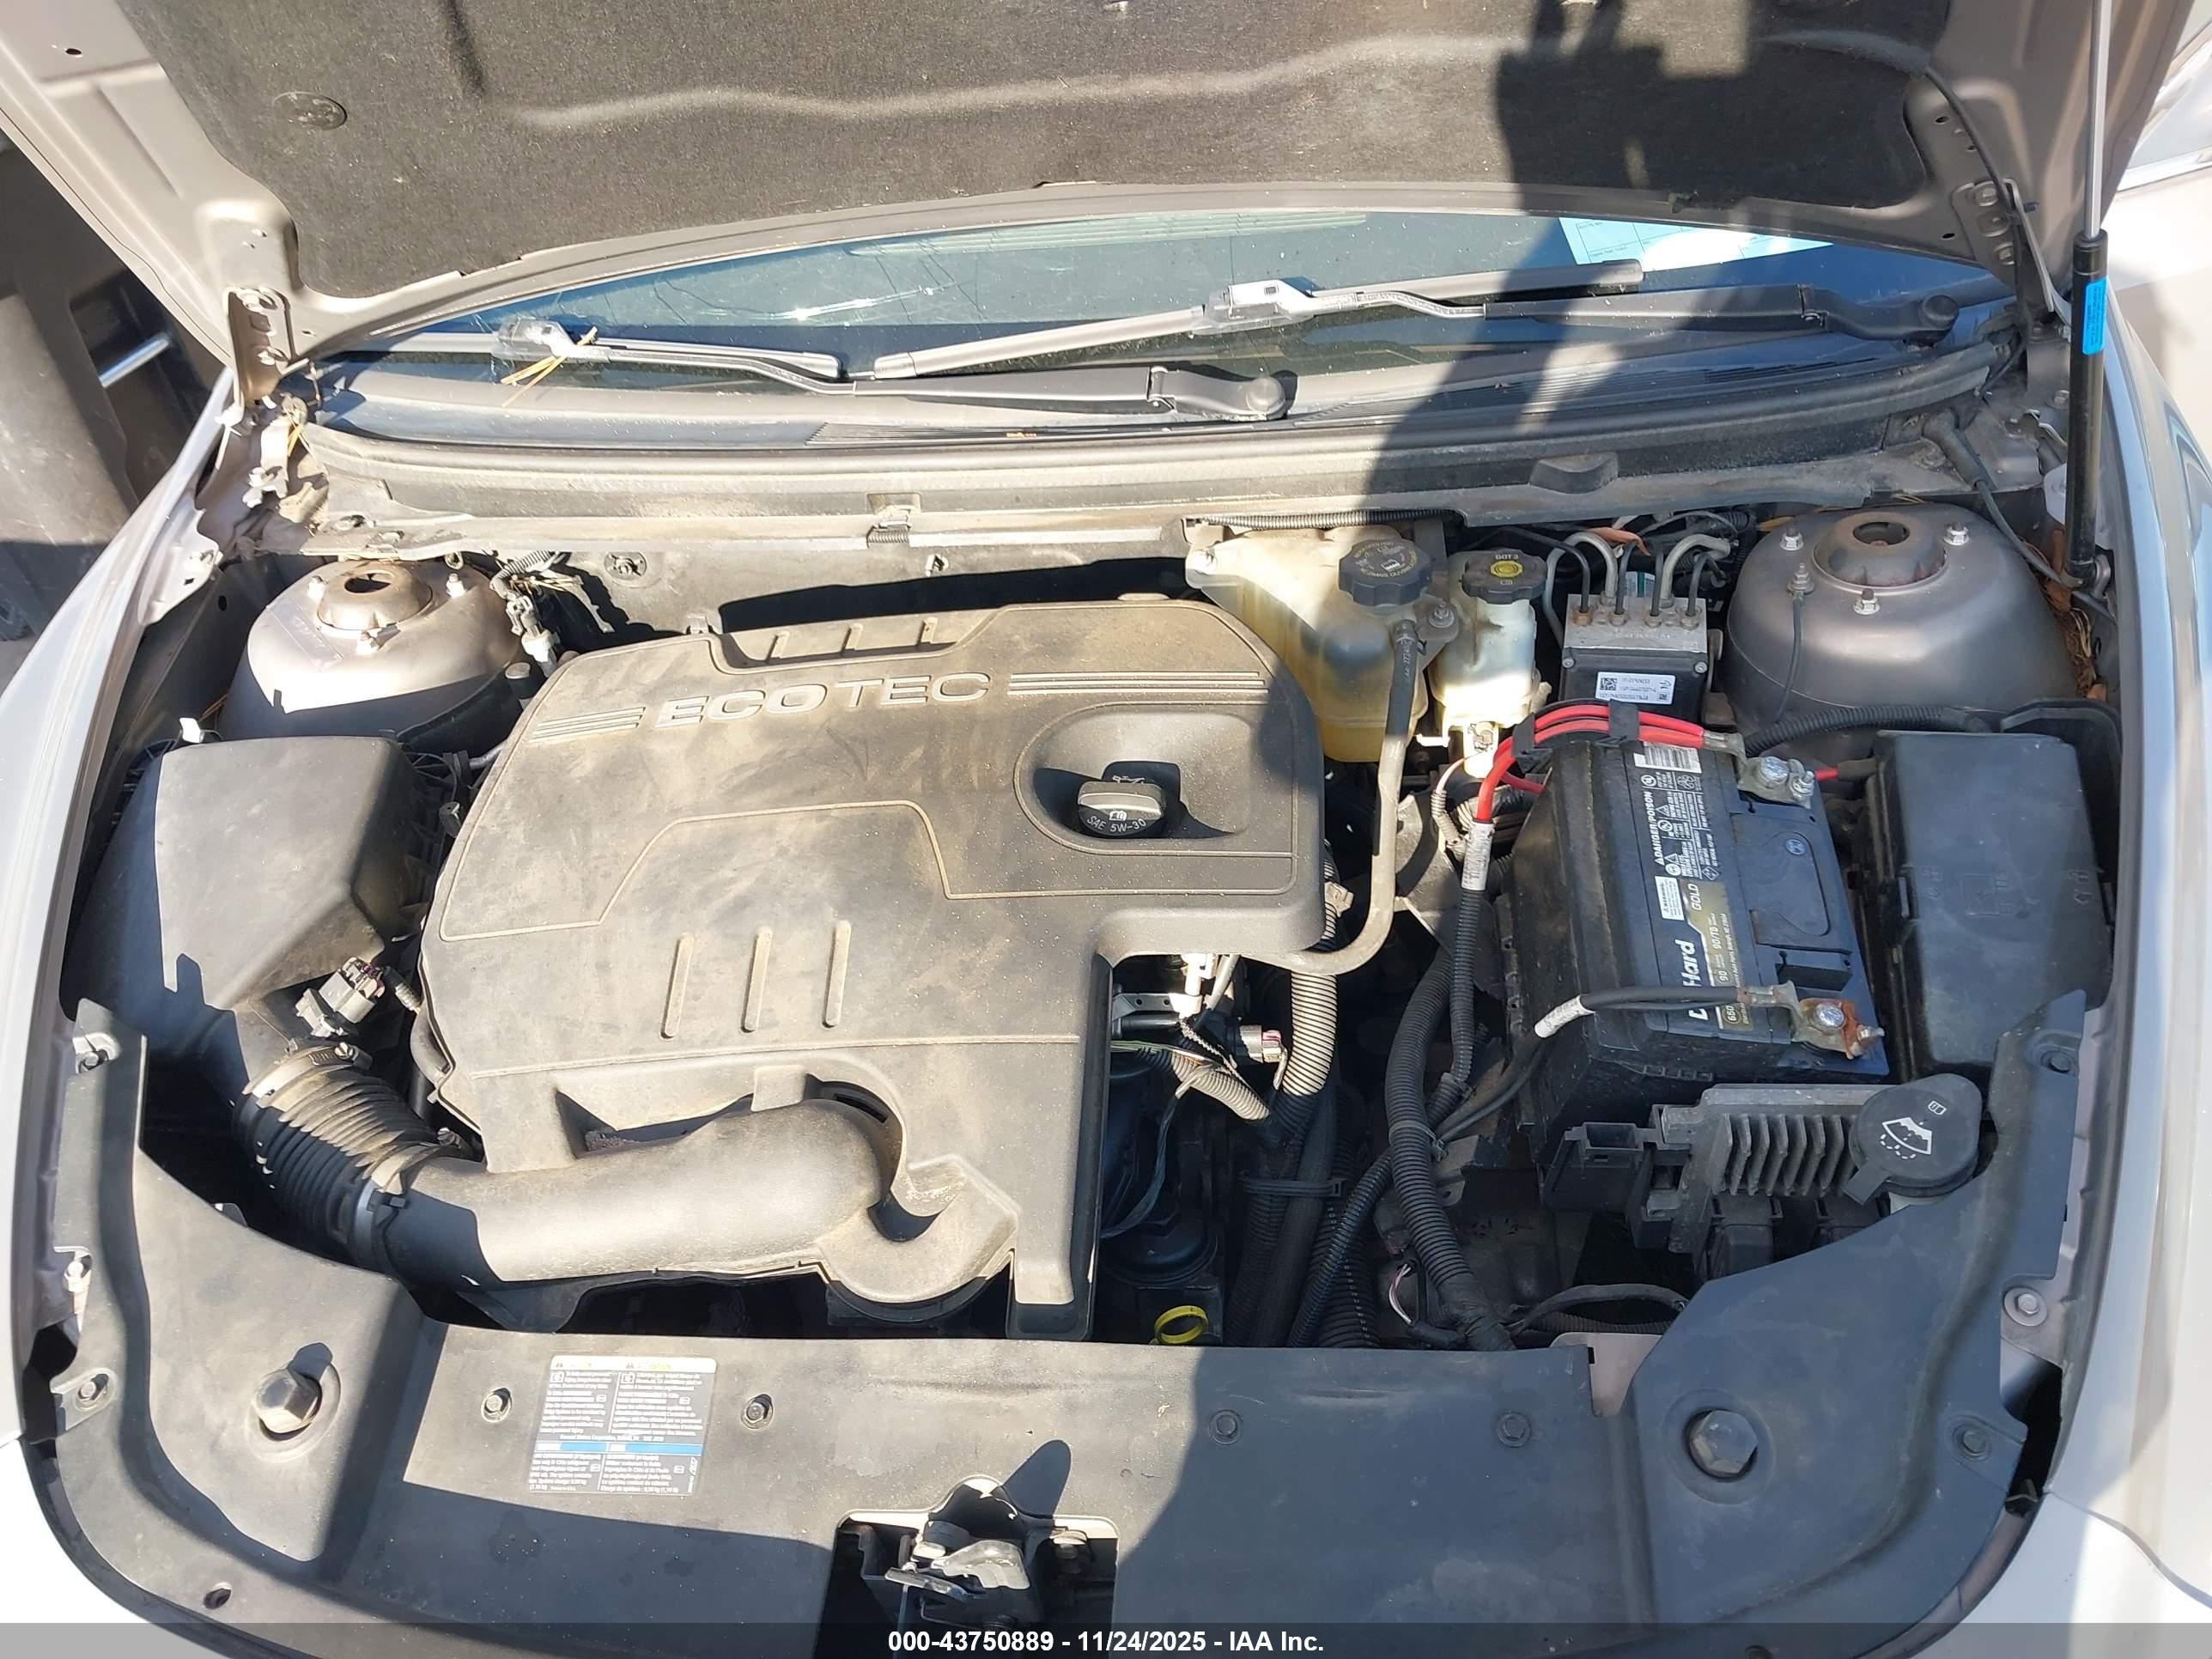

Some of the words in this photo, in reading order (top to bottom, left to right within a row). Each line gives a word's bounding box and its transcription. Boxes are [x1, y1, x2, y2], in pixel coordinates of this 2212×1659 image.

[654, 672, 991, 729] ECOTEC
[1086, 815, 1107, 830] SAE
[1109, 817, 1147, 833] 5W-30
[1643, 791, 1664, 858] DANGER/POISON
[1687, 883, 1703, 911] GOLD
